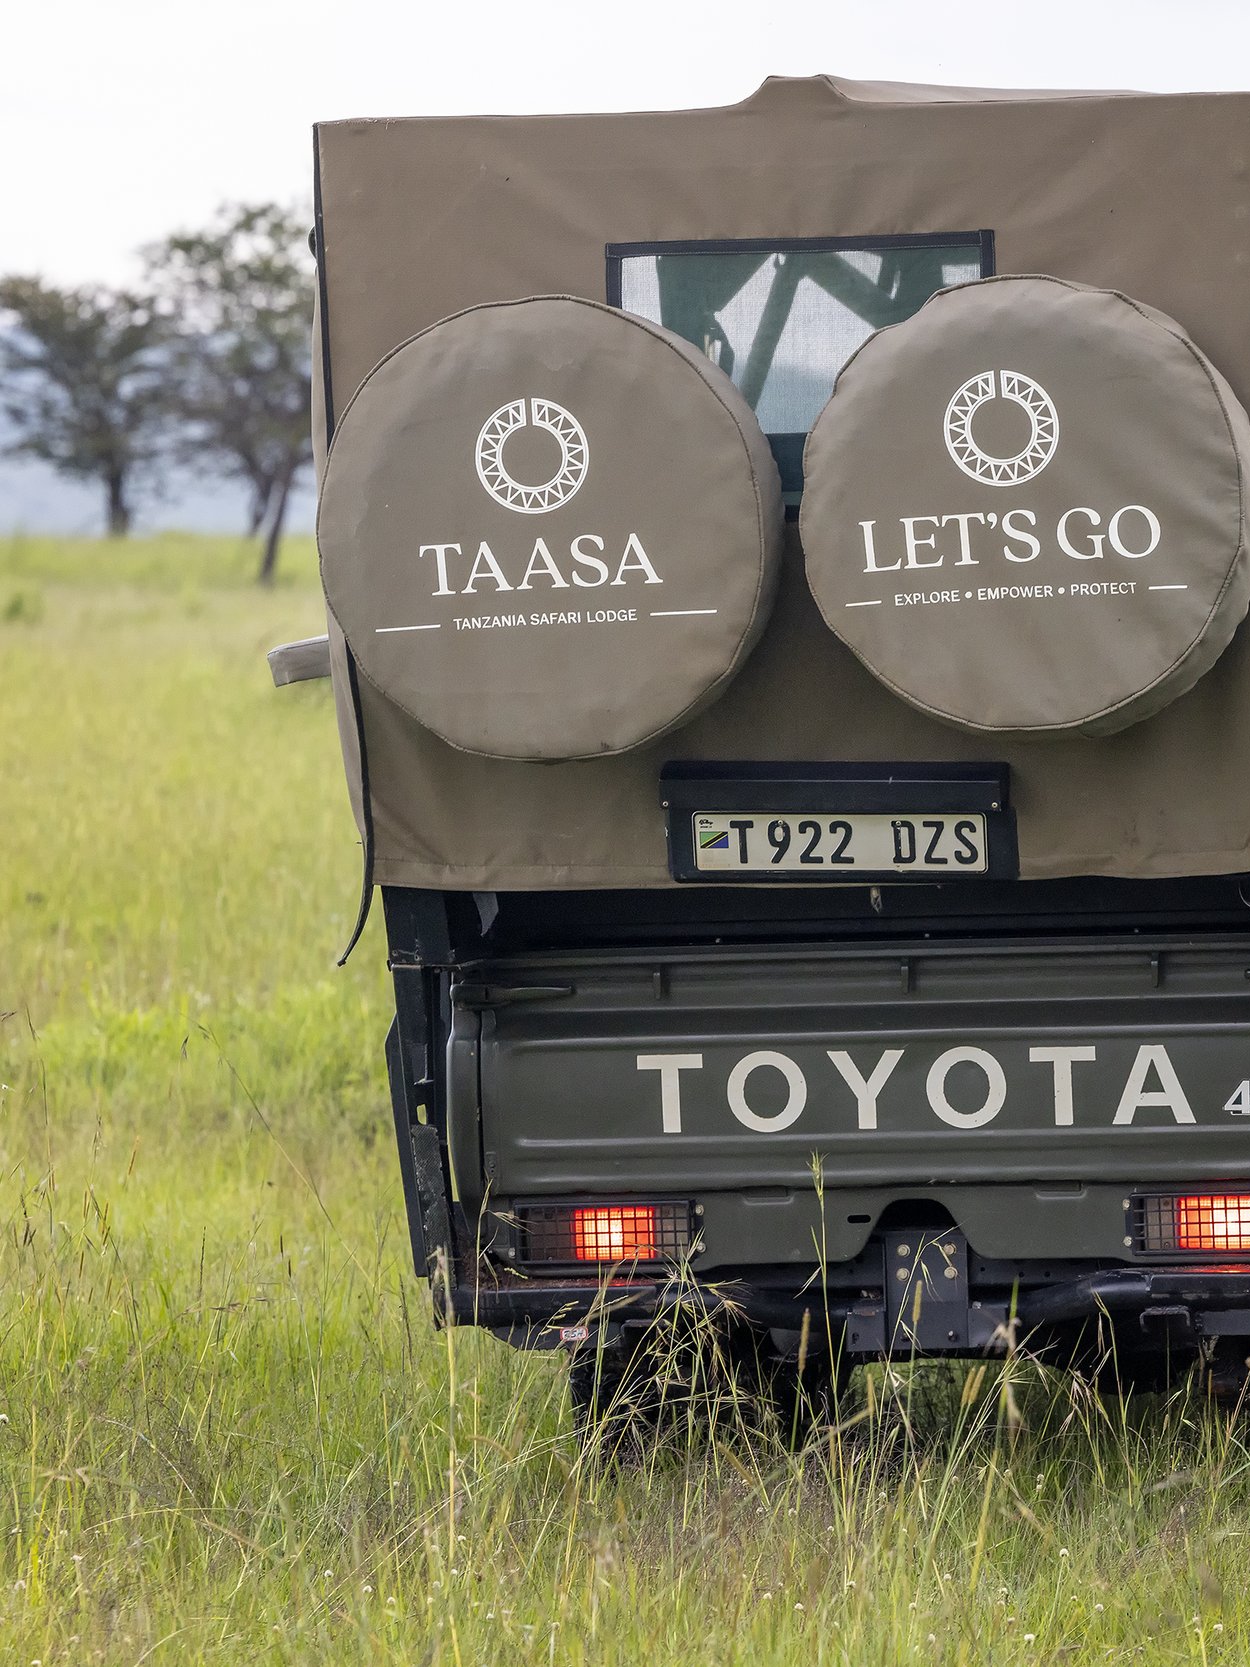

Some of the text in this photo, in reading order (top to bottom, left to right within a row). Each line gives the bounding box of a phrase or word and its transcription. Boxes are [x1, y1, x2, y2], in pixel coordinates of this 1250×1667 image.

[419, 532, 664, 596] TAASA
[858, 505, 1161, 574] LET’S GO
[453, 608, 638, 631] TANZANIA SAFARI LODGE
[894, 582, 1137, 607] EXPLORE EMPOWER PROTECT
[891, 820, 979, 865] DZS
[637, 1044, 1197, 1134] TOYOTA
